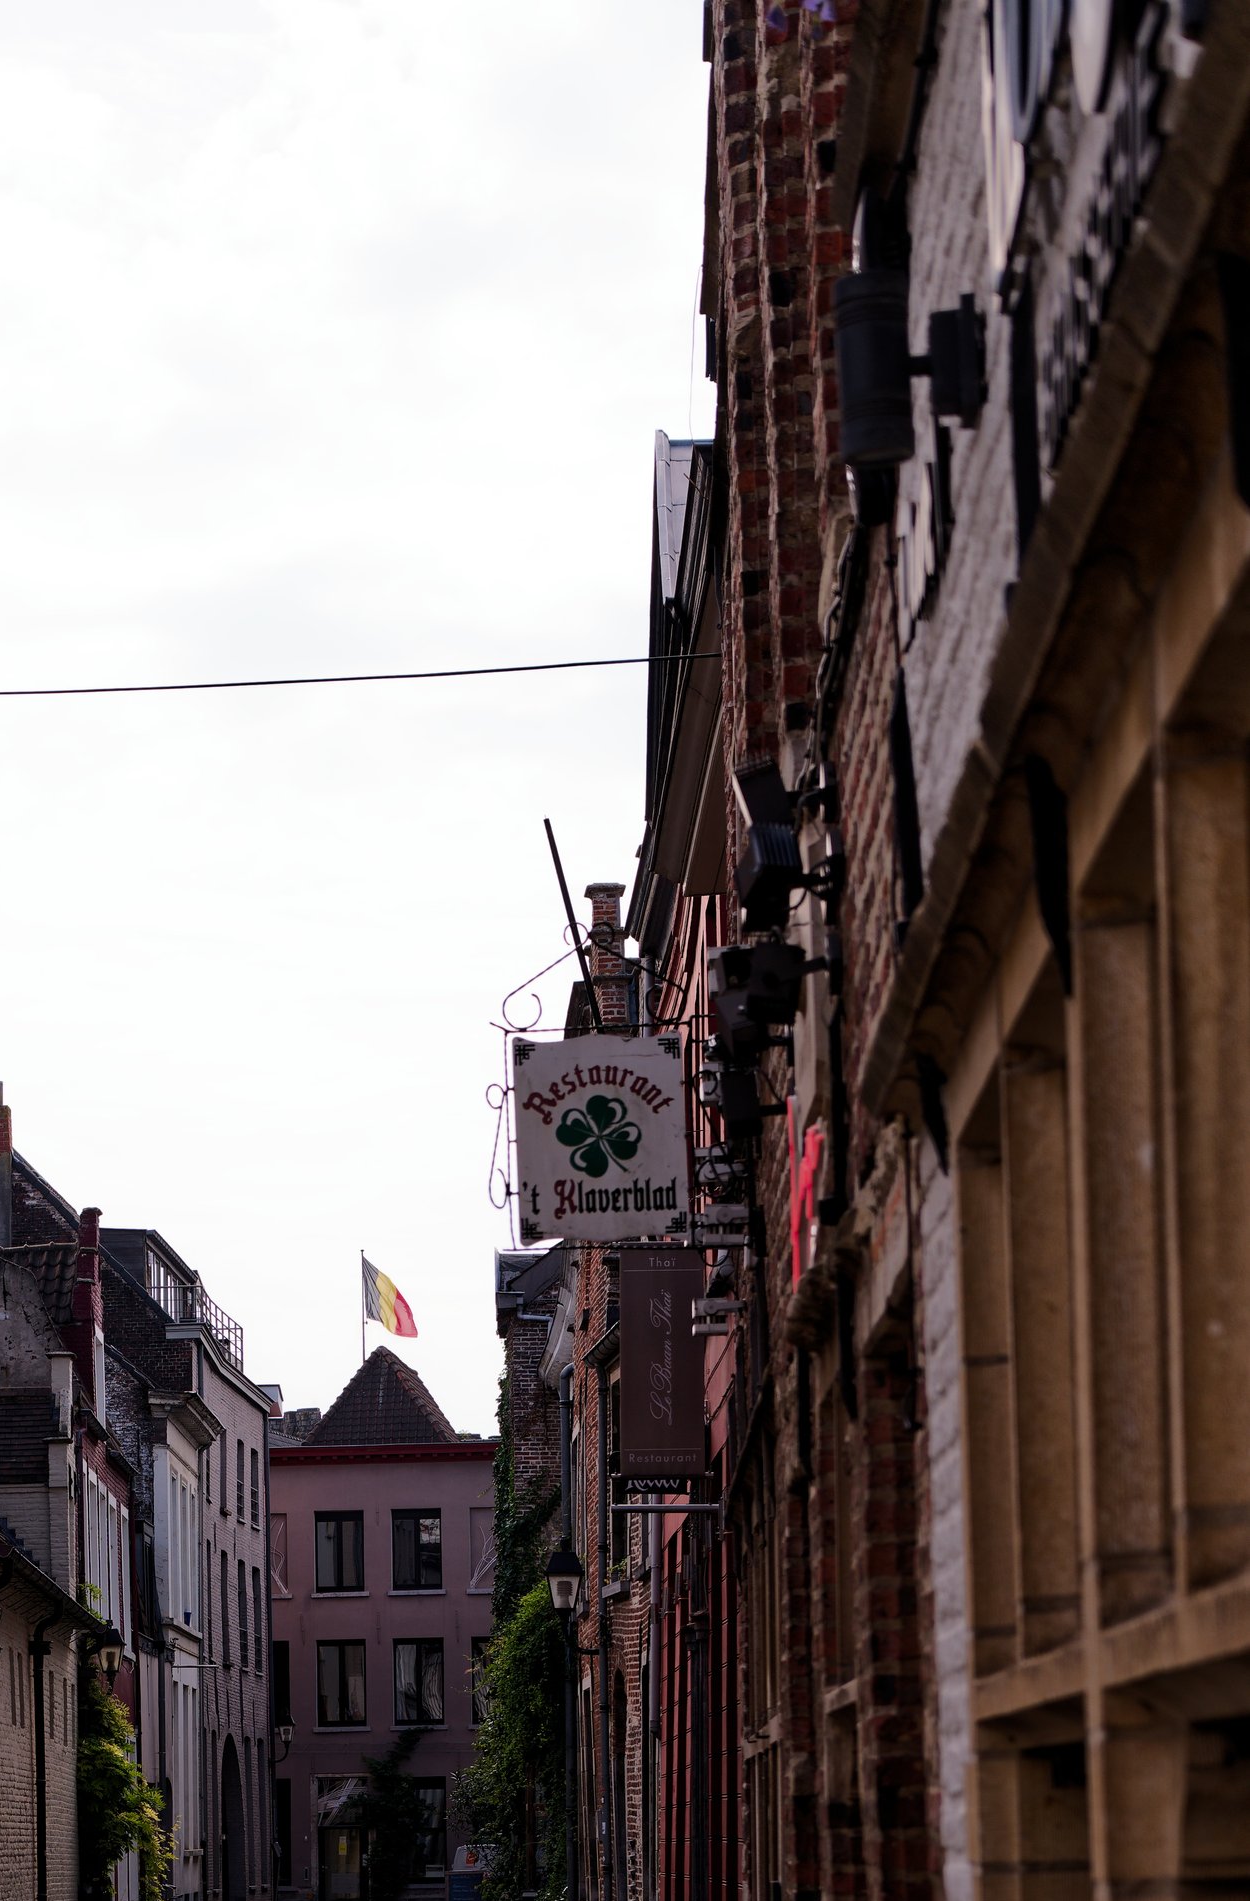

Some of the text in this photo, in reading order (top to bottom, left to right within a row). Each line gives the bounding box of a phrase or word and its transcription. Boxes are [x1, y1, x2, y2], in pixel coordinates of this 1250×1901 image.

[522, 1063, 675, 1125] Restaurant
[522, 1176, 678, 1220] 't Klaverblad
[648, 1256, 676, 1268] Thaï
[649, 1288, 673, 1426] Le Baan Thaï
[628, 1452, 697, 1463] Restaurant
